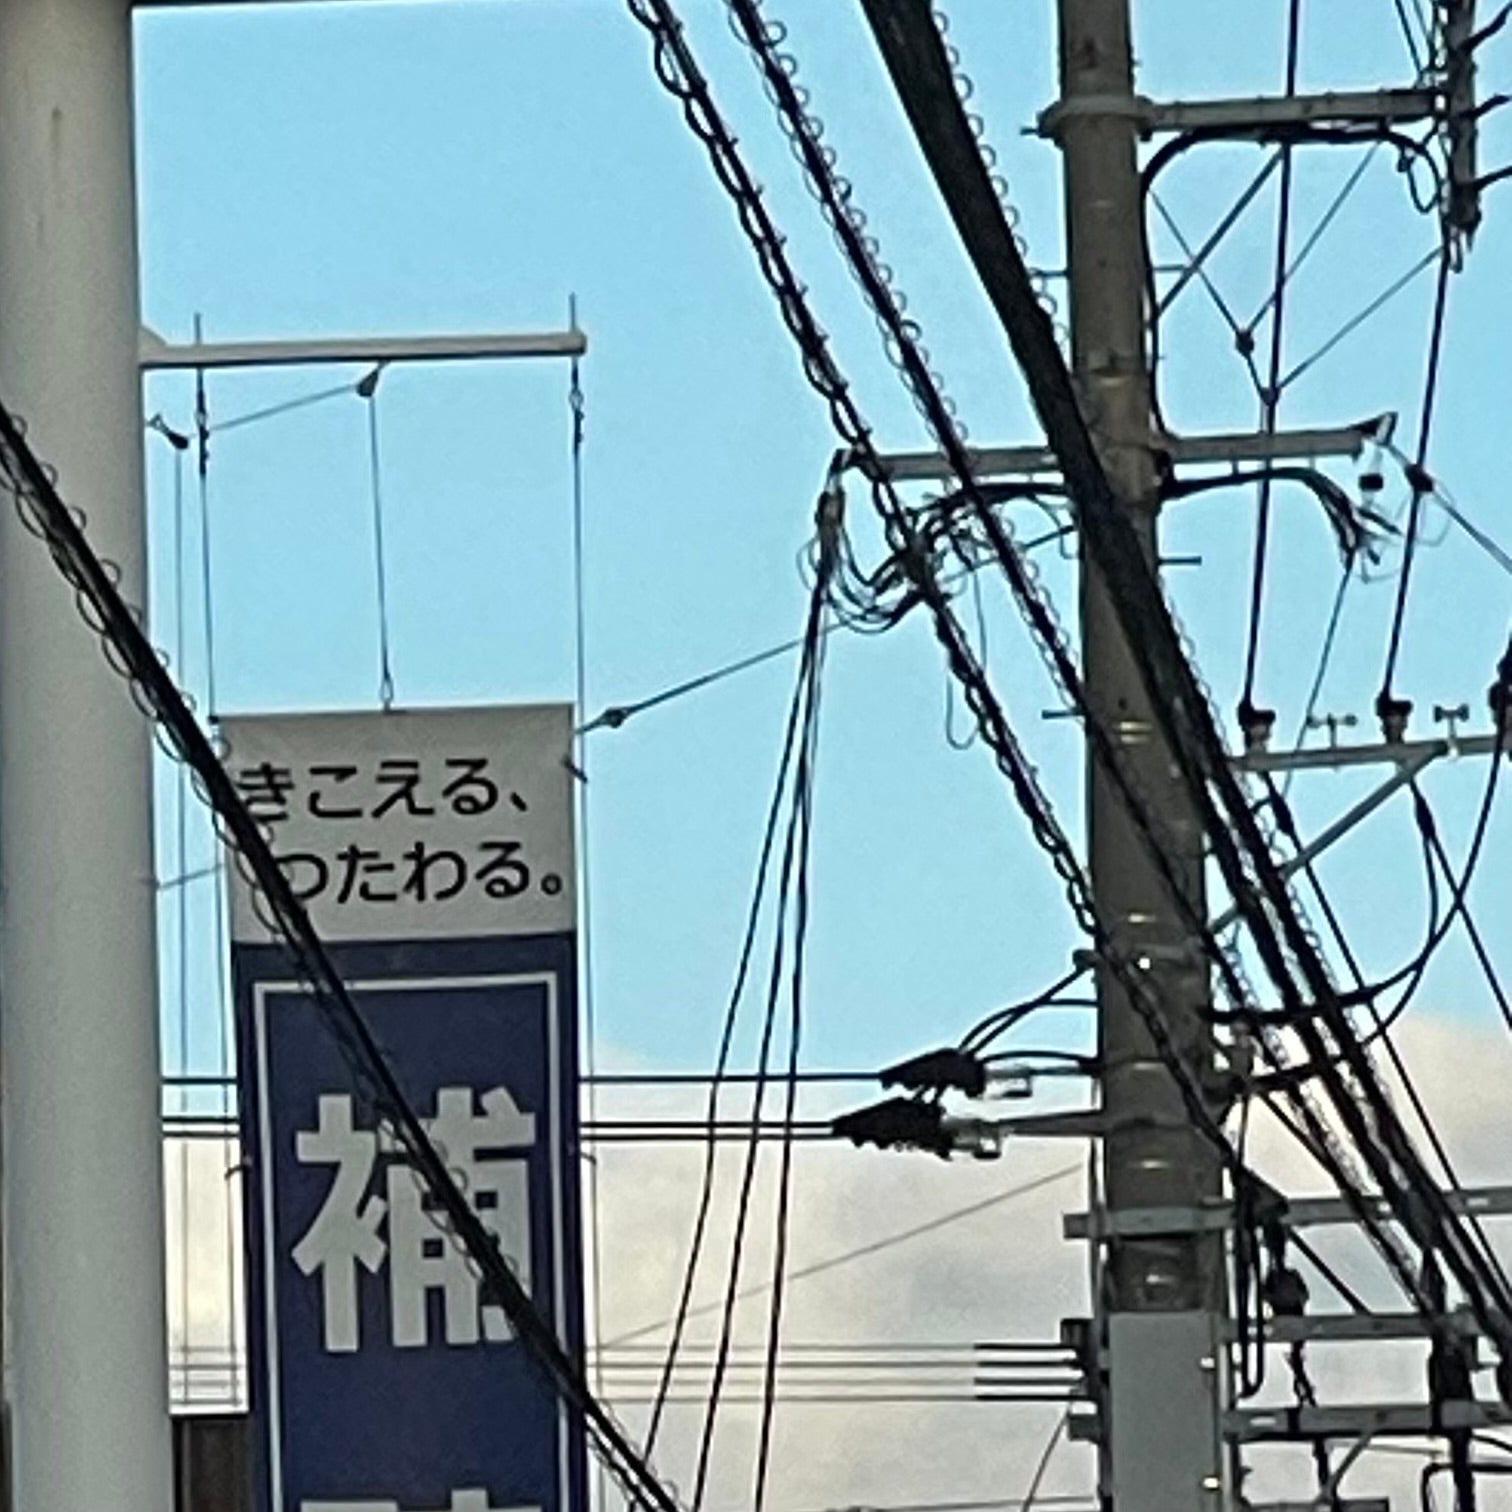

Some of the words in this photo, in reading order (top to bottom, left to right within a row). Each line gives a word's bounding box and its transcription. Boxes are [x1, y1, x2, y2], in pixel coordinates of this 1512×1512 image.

[238, 757, 528, 823] きこえる、
[291, 1086, 541, 1512] 補
